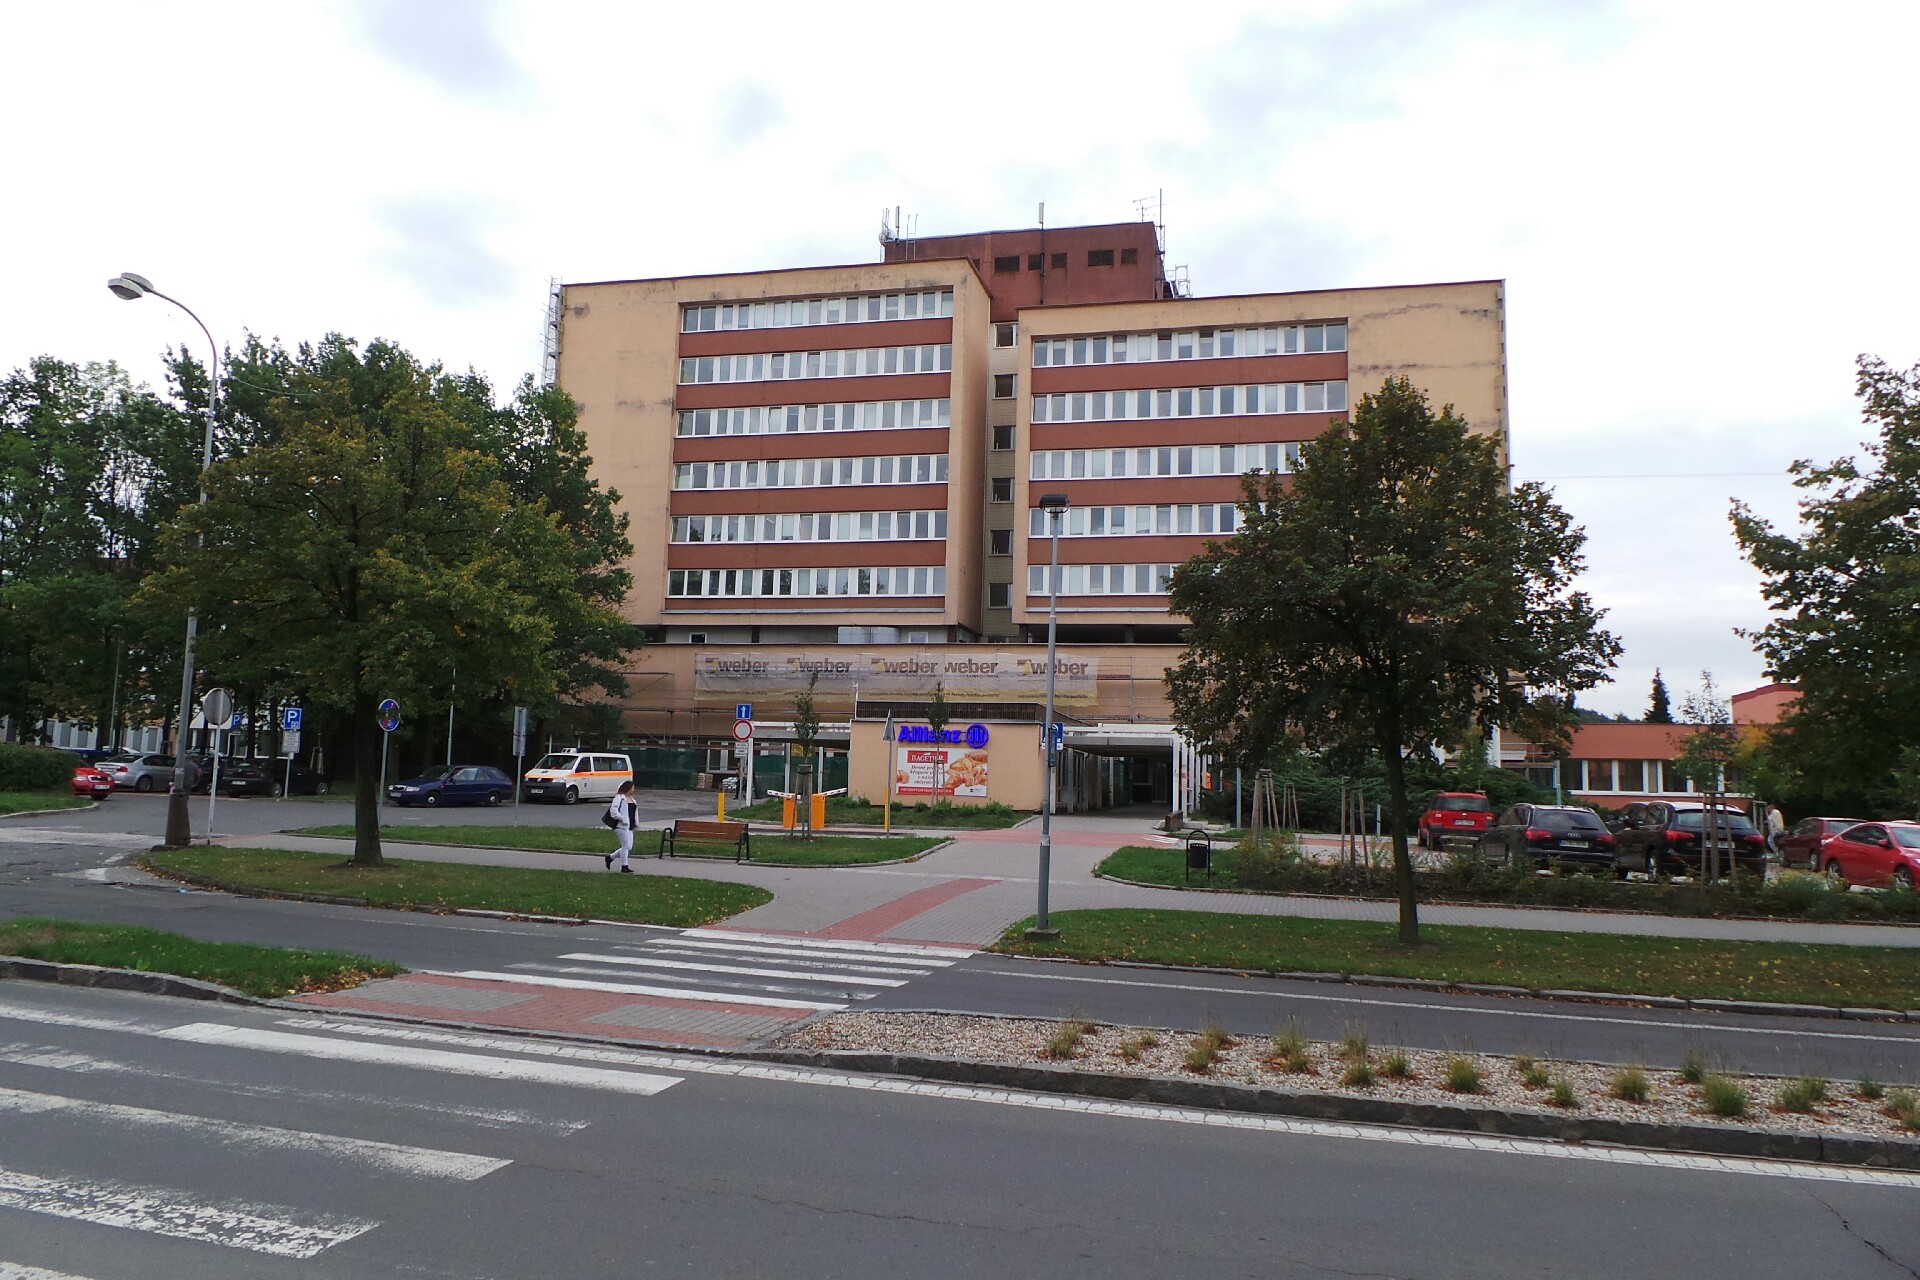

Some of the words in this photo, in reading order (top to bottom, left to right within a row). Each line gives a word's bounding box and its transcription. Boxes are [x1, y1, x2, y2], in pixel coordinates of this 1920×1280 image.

[718, 658, 769, 672] weber
[800, 658, 852, 673] weber
[883, 658, 939, 674] weber
[944, 658, 998, 674] weber
[288, 711, 298, 723] P
[898, 726, 962, 743] Allianz
